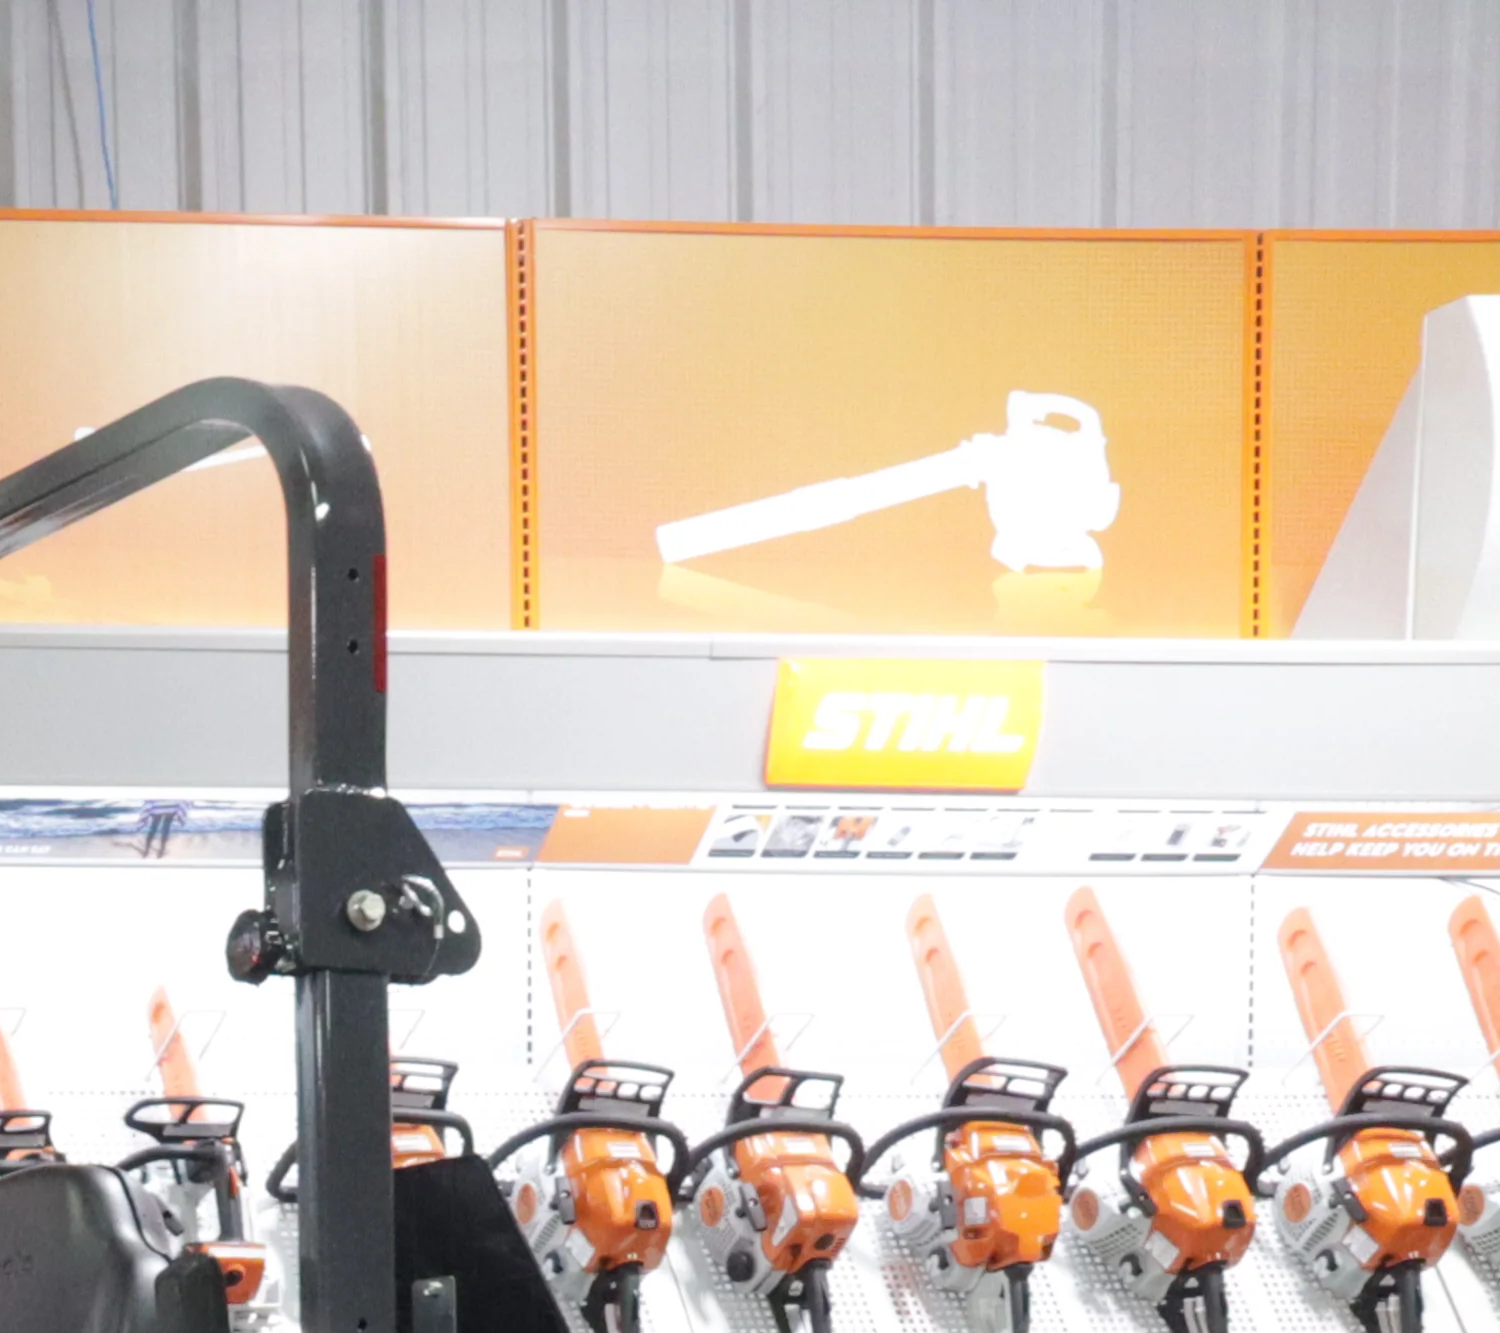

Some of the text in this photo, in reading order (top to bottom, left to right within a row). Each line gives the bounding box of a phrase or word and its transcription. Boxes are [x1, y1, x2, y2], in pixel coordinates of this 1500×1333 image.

[802, 691, 1025, 752] STIHL
[1304, 823, 1358, 837] STIHL
[1403, 843, 1445, 856] YOU
